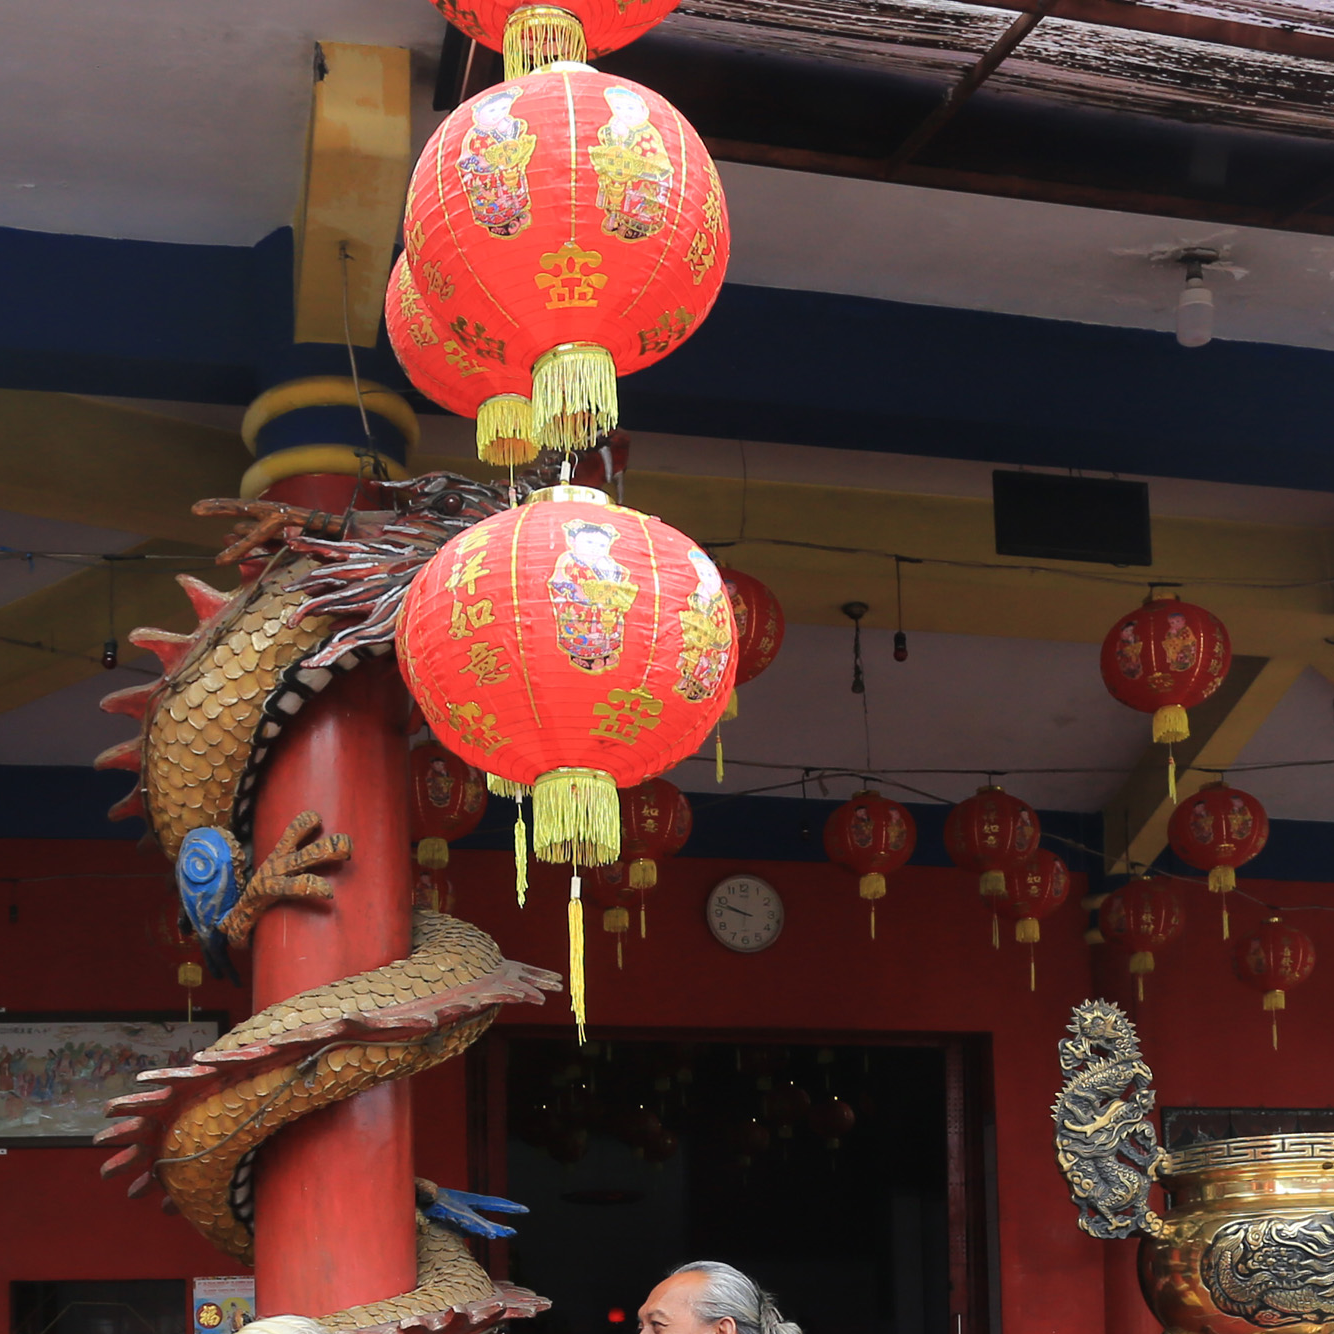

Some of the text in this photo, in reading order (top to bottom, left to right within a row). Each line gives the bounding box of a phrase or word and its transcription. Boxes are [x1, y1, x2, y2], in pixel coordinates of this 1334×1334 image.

[444, 522, 512, 687] 吉祥如意
[199, 1305, 221, 1326] 福
